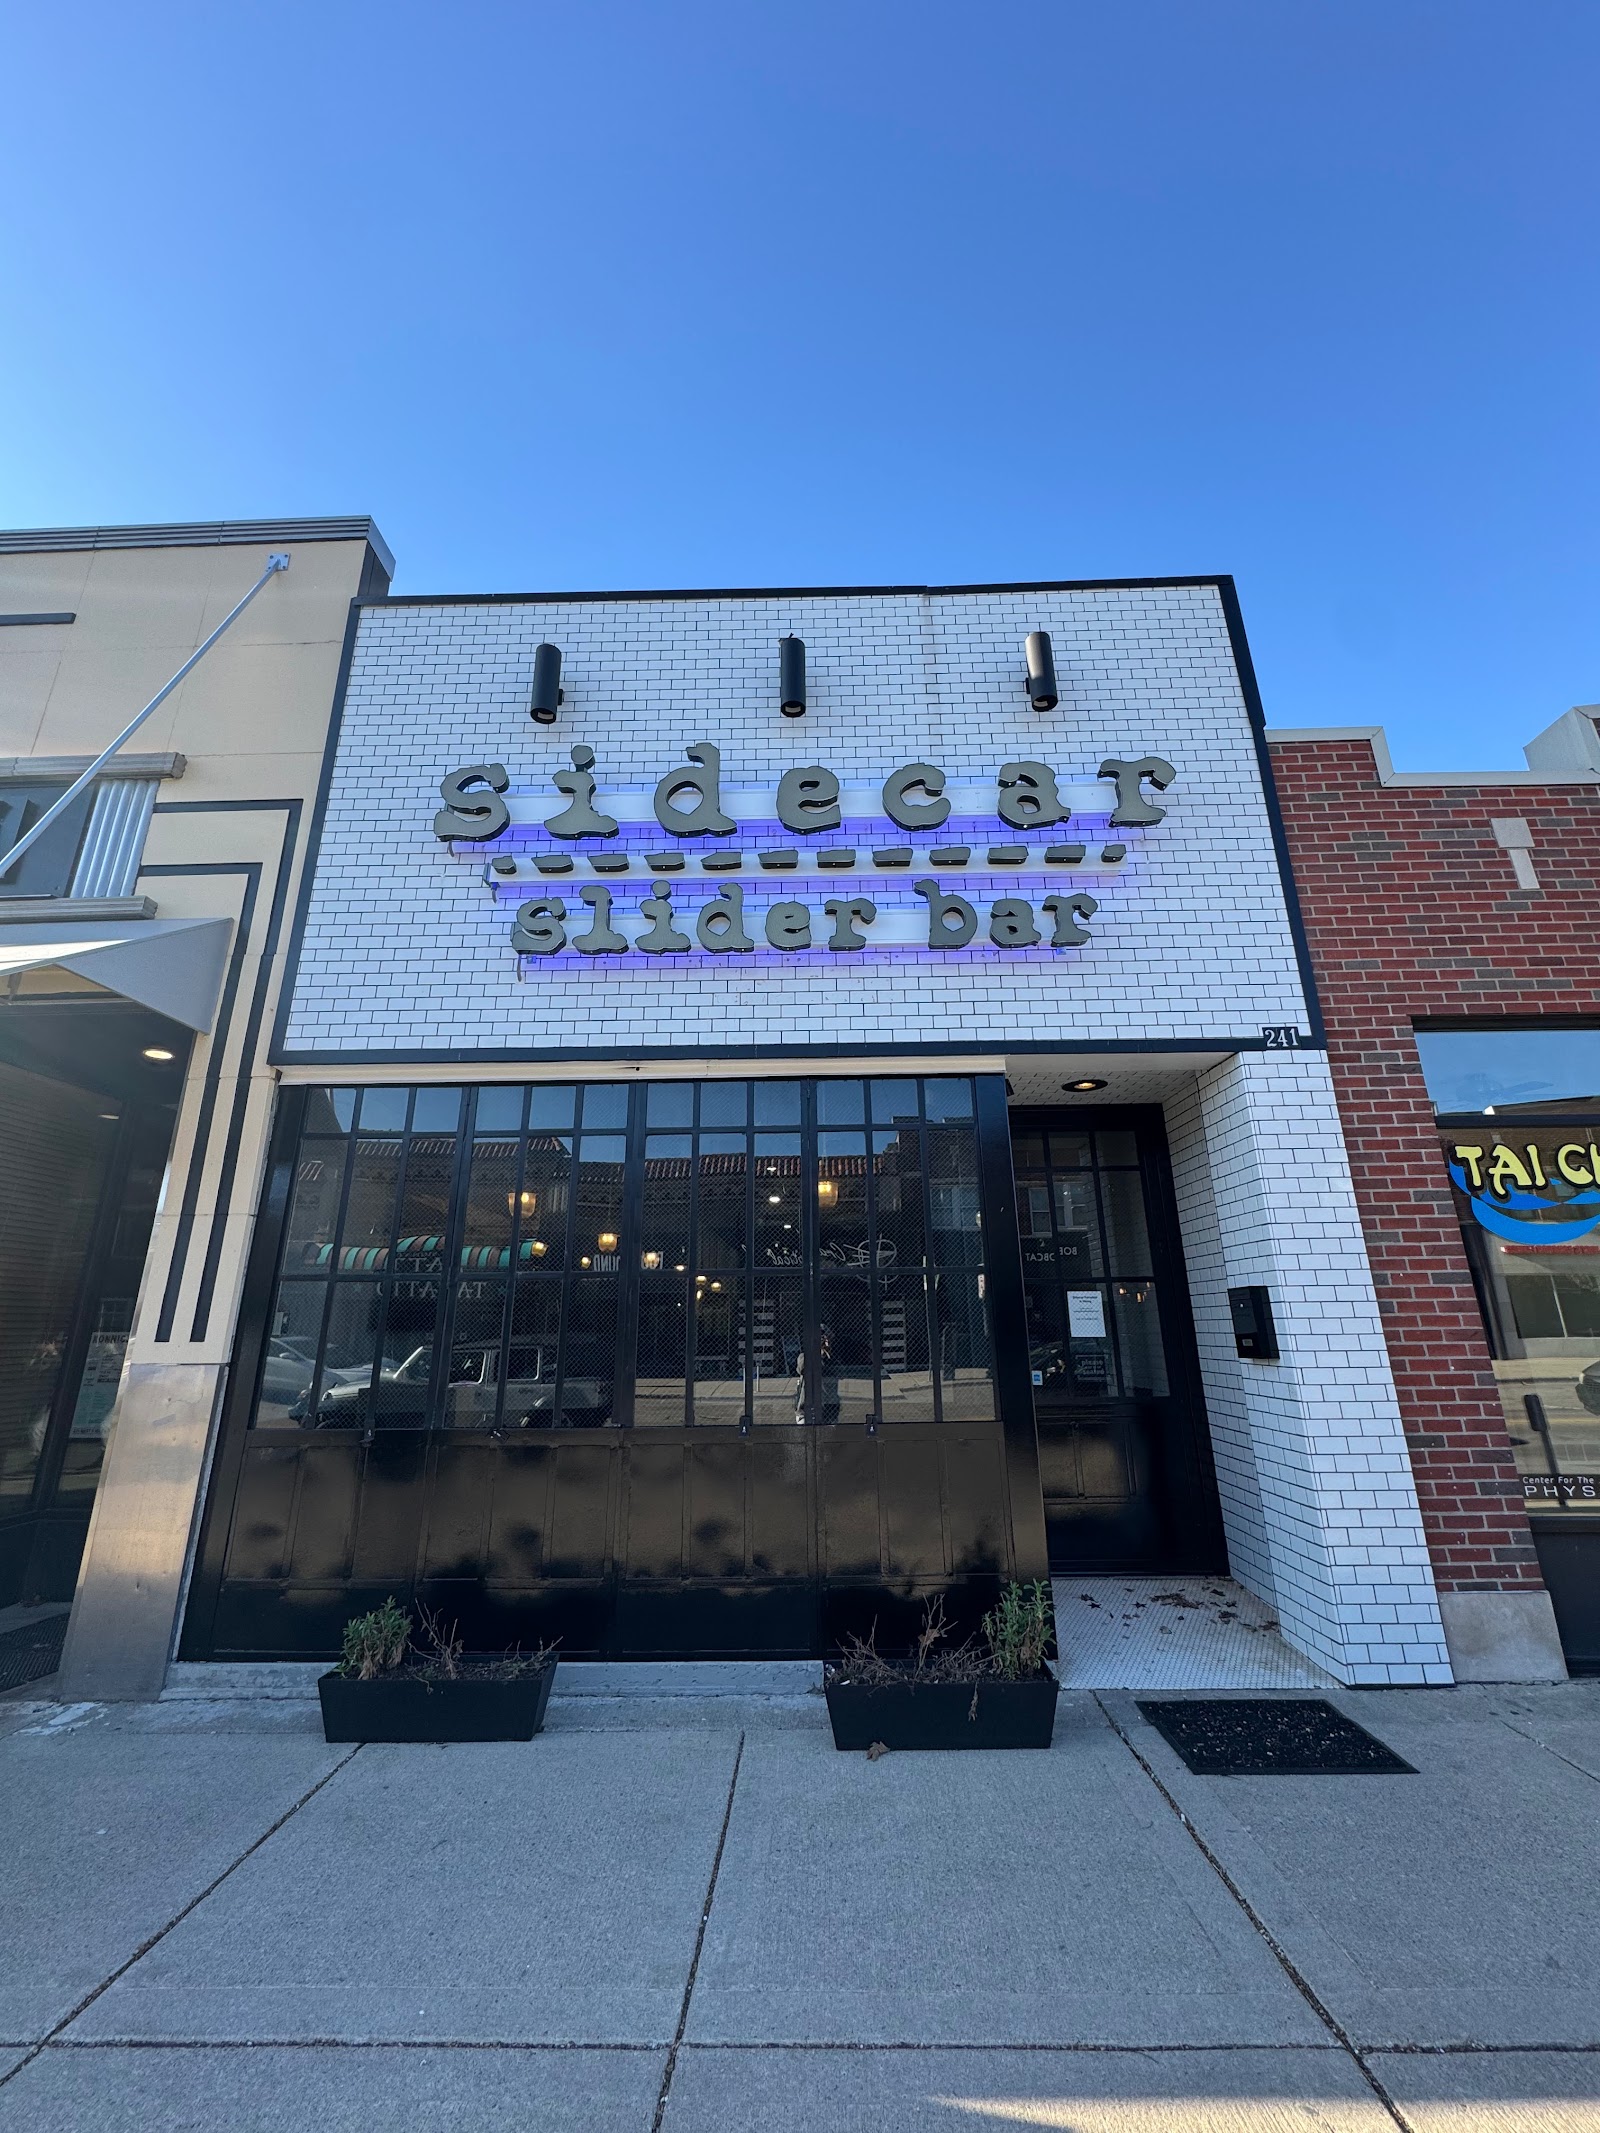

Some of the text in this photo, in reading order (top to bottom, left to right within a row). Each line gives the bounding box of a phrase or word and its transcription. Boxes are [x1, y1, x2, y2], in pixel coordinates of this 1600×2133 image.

[433, 742, 1176, 842] sidecar
[511, 878, 1099, 955] slider bar
[1264, 1028, 1299, 1047] 241
[1454, 1144, 1546, 1195] TAI
[1522, 1476, 1594, 1484] Center For The
[1524, 1485, 1596, 1497] PHYS
